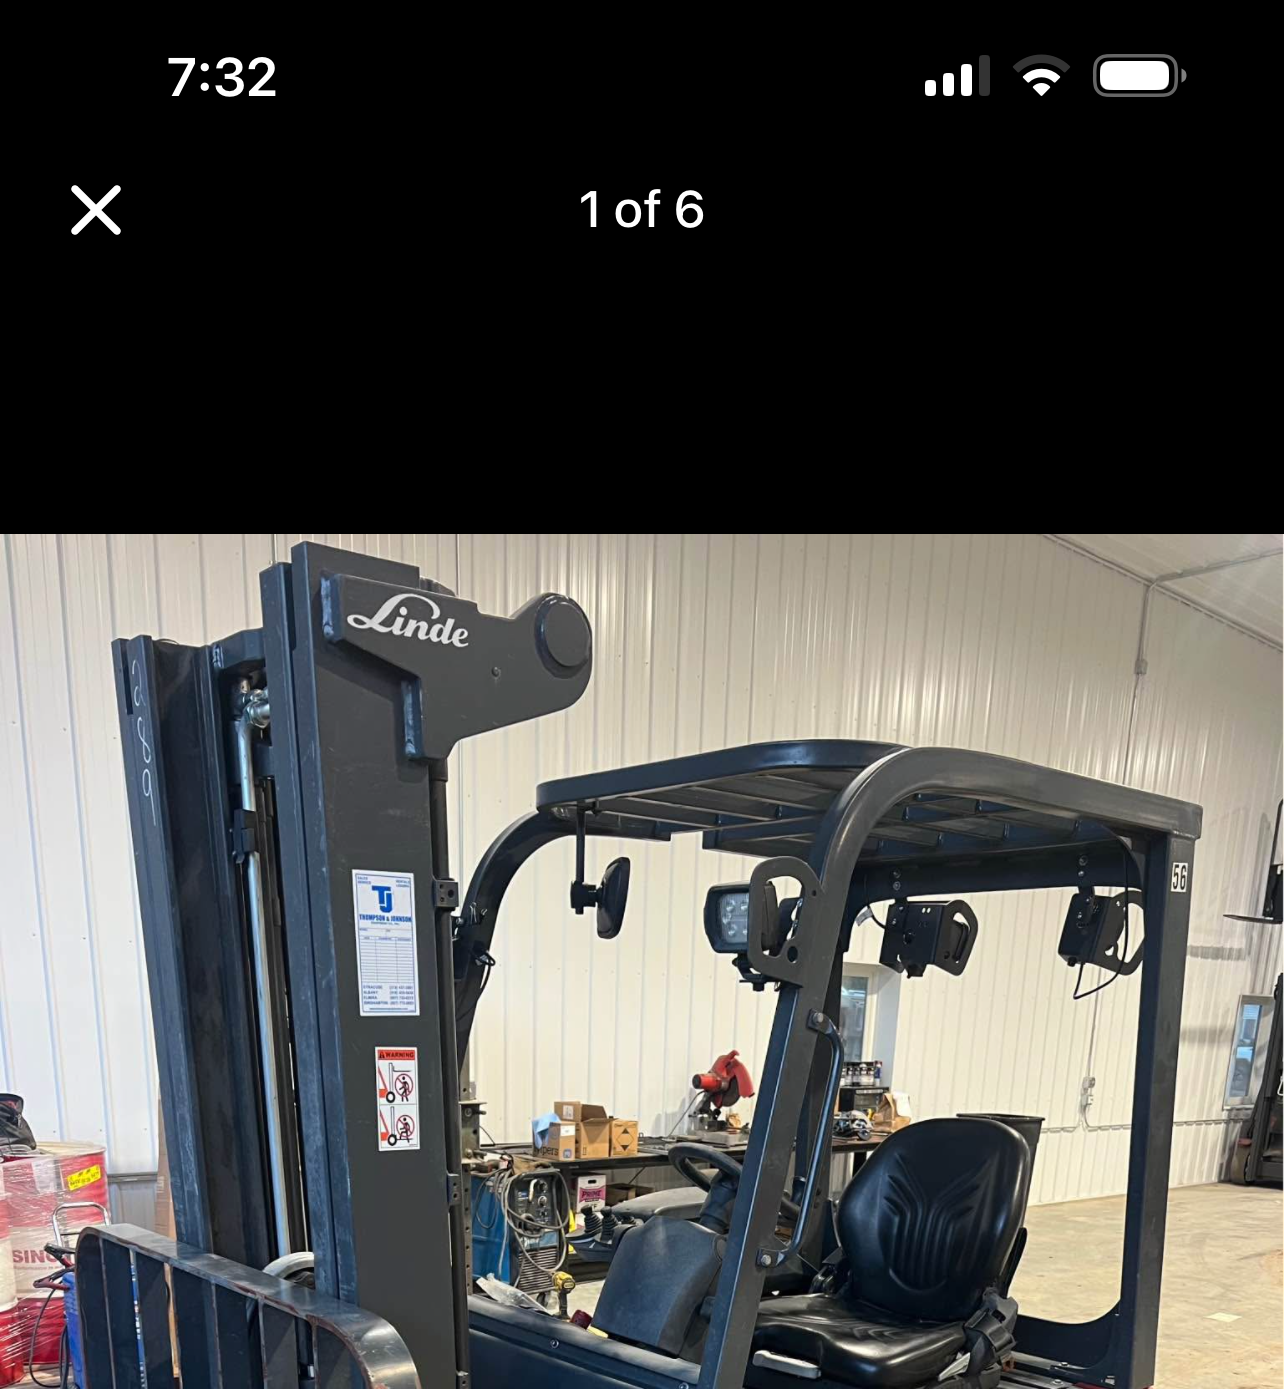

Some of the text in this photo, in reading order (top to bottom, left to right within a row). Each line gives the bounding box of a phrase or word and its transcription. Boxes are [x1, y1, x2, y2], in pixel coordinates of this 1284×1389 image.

[347, 593, 469, 648] Linde
[1173, 864, 1187, 890] 56
[371, 885, 393, 913] TJ
[359, 913, 385, 922] THOMPSON
[385, 1051, 414, 1059] WARNING
